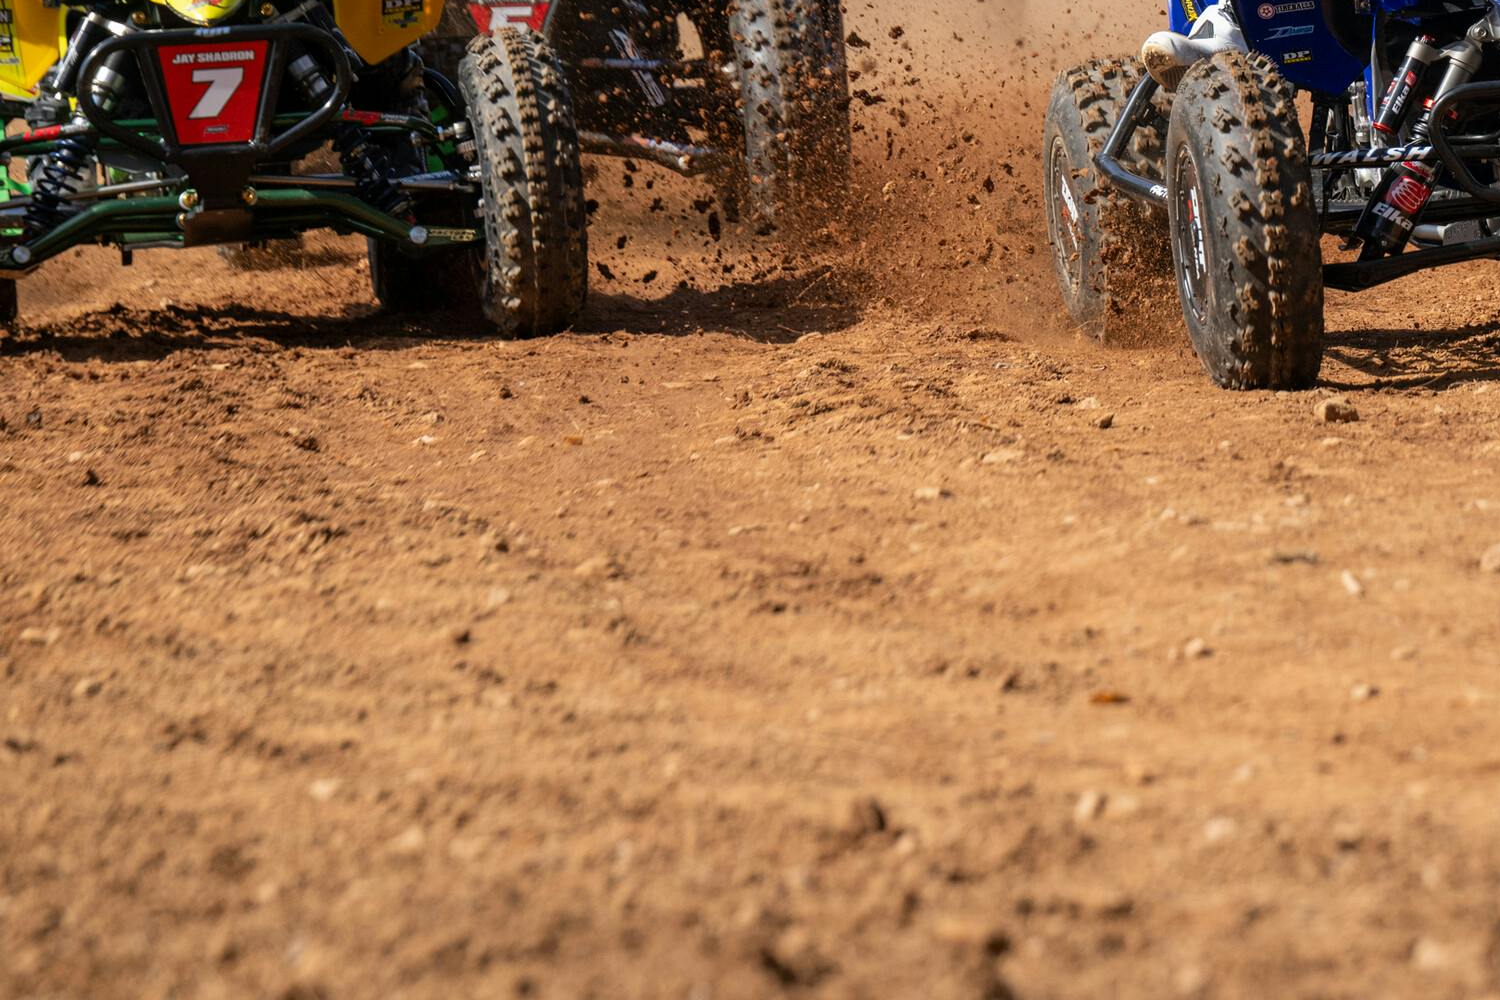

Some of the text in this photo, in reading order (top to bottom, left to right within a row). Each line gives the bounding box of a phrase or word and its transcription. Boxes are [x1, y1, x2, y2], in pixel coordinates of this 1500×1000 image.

[172, 50, 255, 65] JAY SHADRON
[188, 67, 244, 120] 7
[1391, 85, 1410, 115] Elka
[1312, 146, 1432, 166] WALSH
[1371, 201, 1414, 232] Elka
